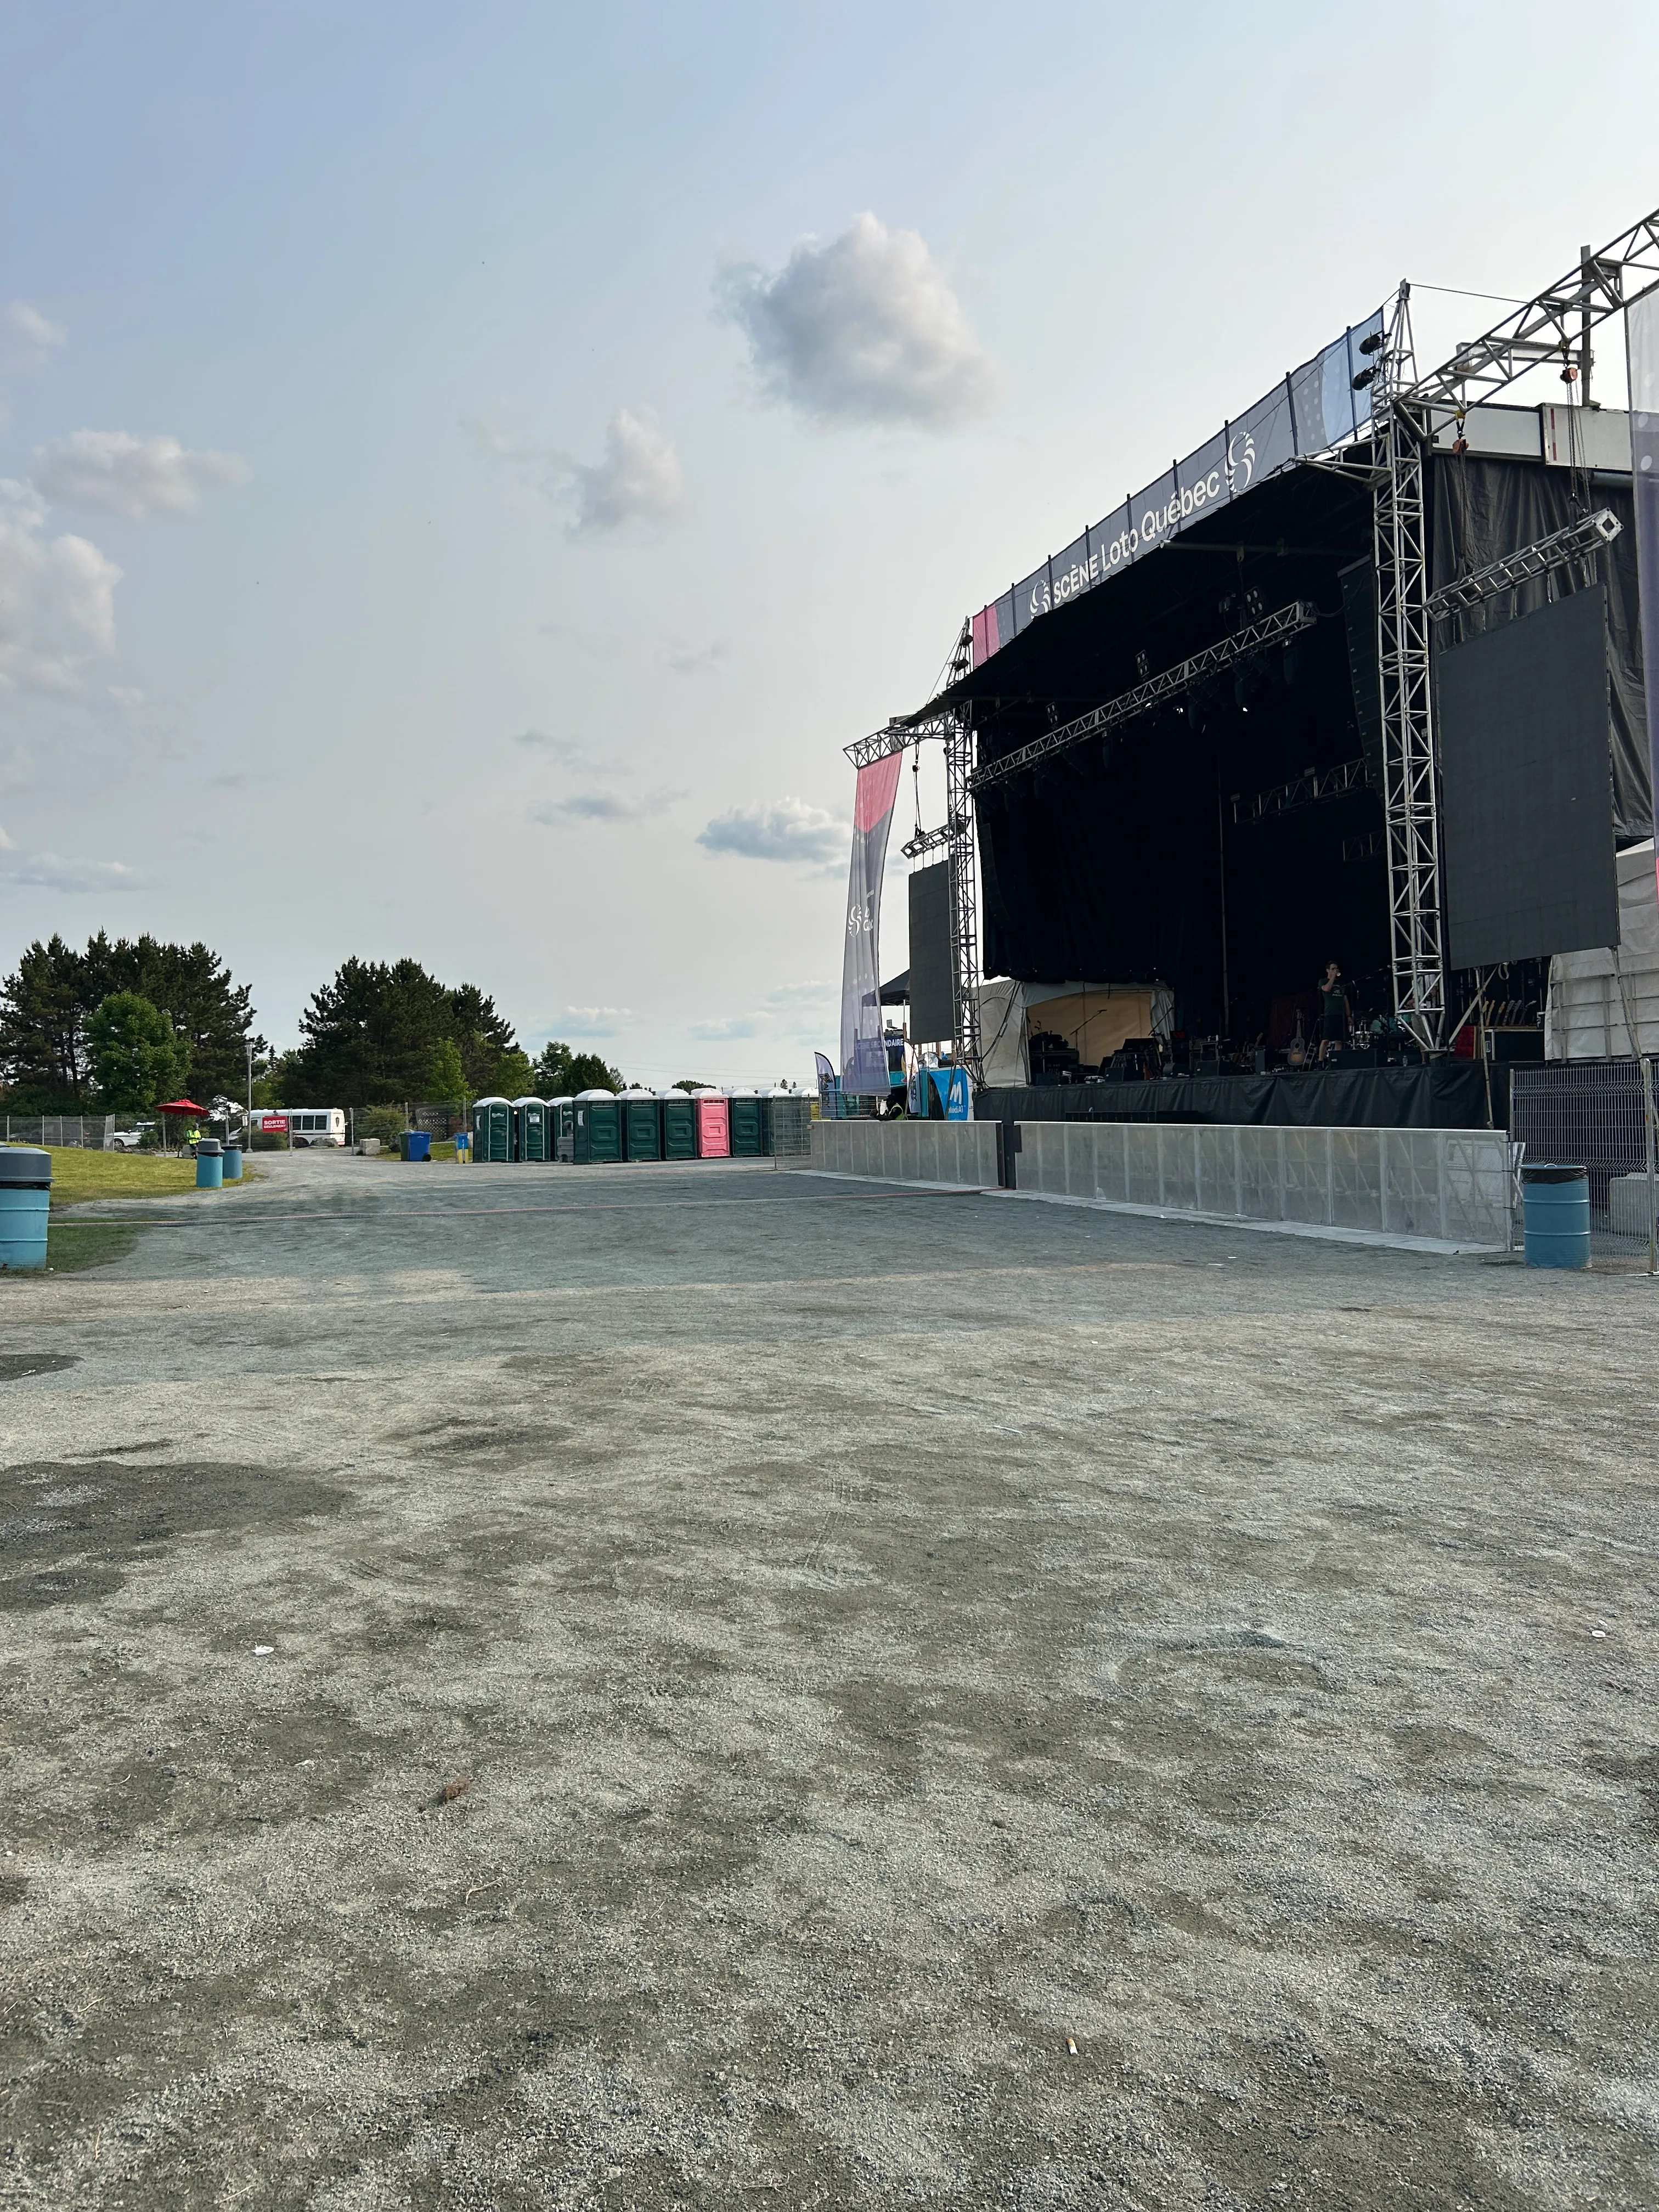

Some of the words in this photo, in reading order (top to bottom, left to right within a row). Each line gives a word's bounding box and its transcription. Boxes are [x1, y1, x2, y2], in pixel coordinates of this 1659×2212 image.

[1053, 554, 1099, 604] SCÈNE
[1101, 528, 1138, 572] Loto
[1141, 471, 1220, 541] Québec
[870, 1038, 904, 1048] SECNDAIRE
